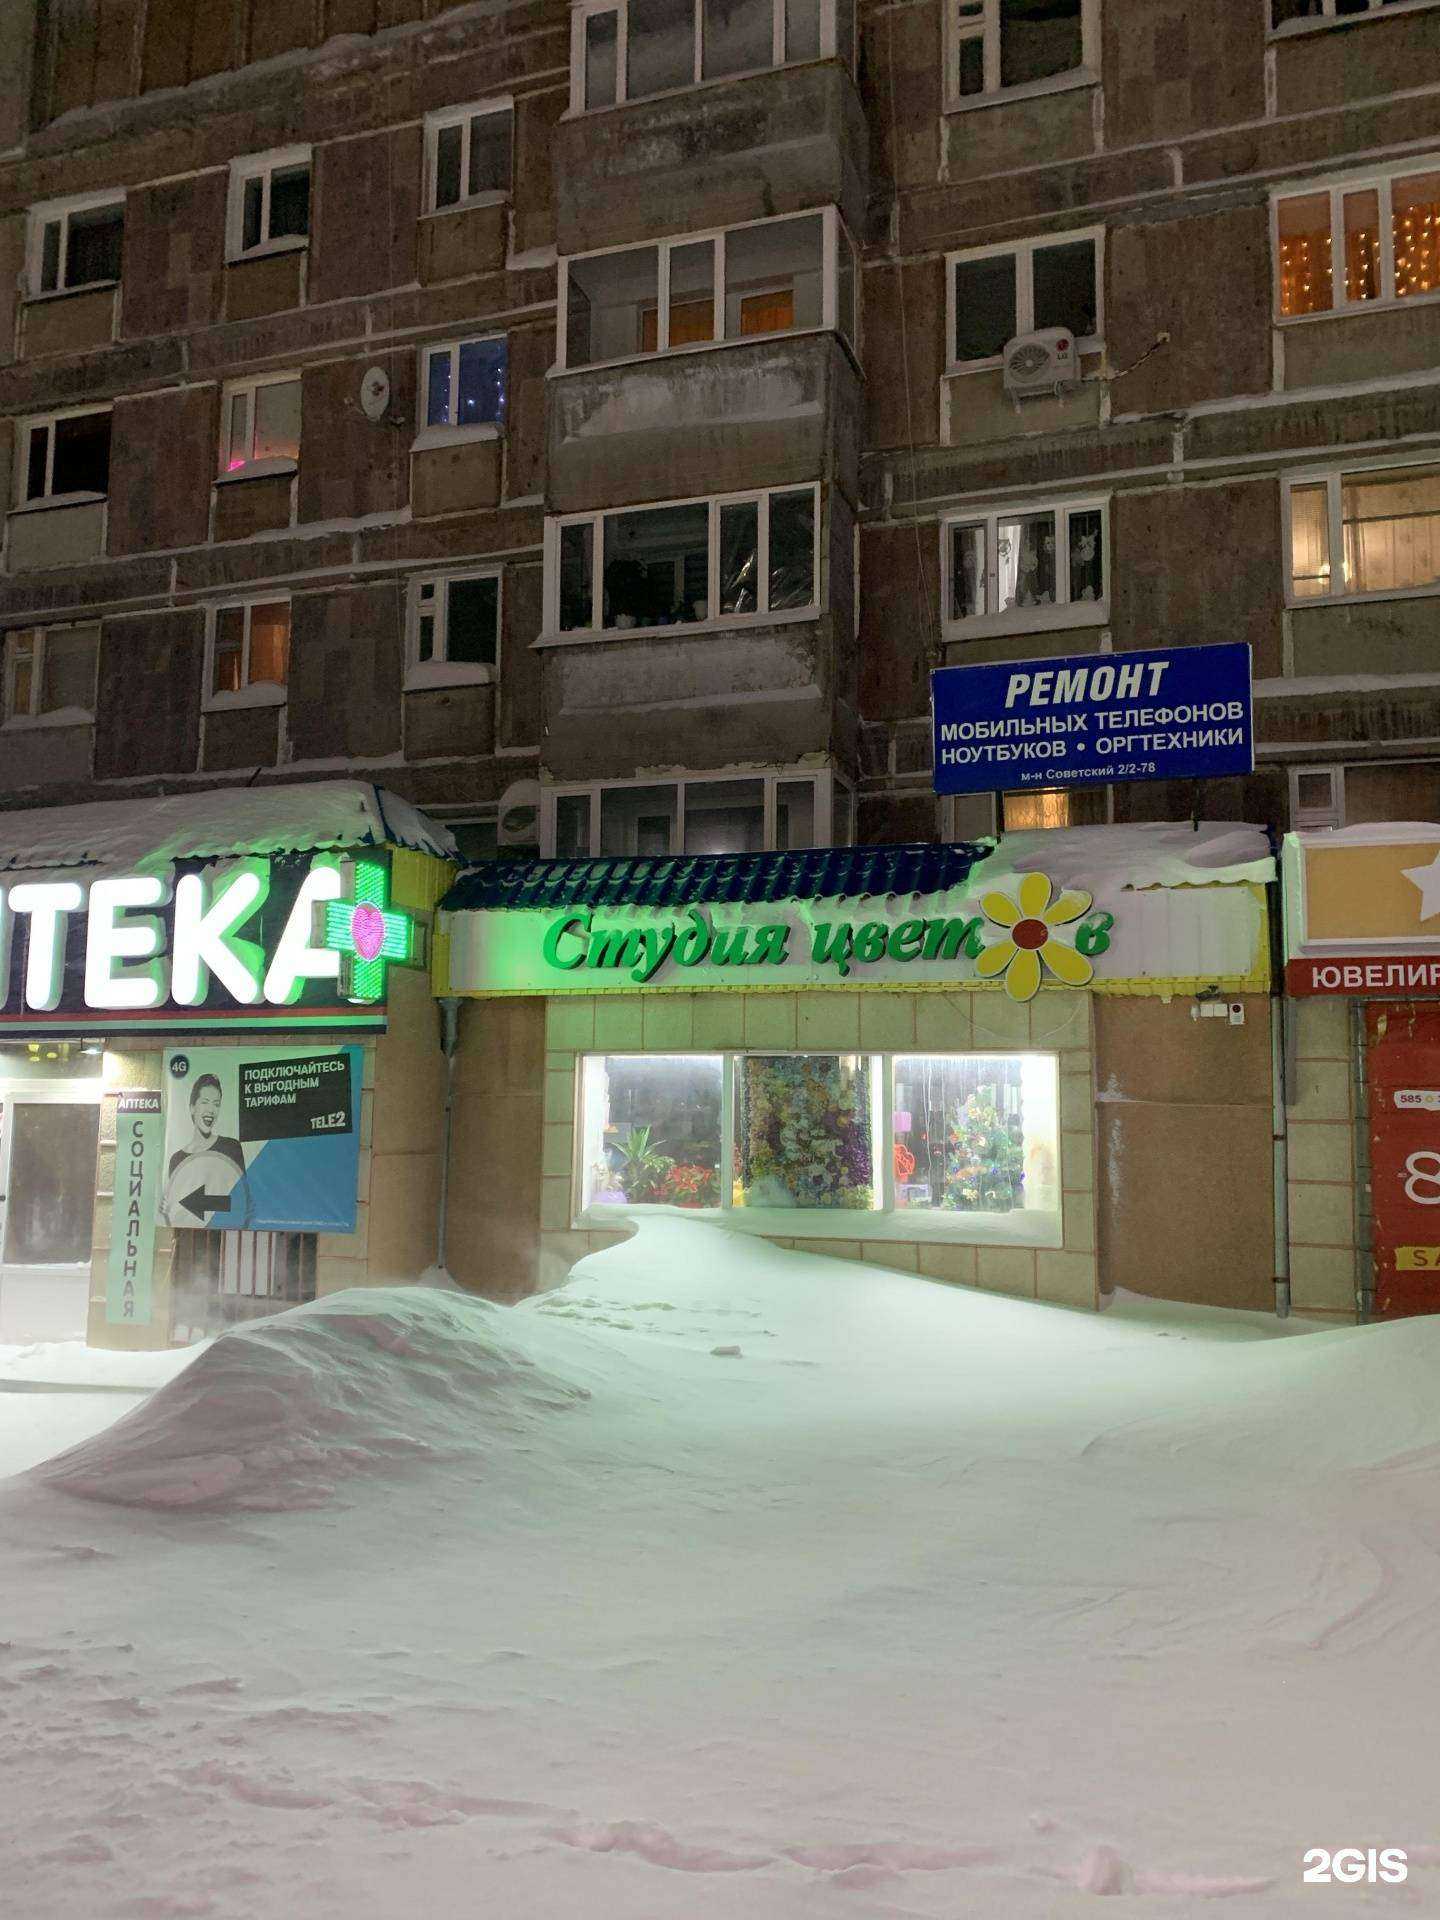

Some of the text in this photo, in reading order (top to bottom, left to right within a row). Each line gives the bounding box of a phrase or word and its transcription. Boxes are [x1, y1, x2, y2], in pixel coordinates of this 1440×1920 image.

[1004, 661, 1169, 708] РЕМОНТ
[941, 701, 1244, 741] МОБИЛЬНЫХ ТЕЛЕФОНОВ
[941, 727, 1243, 765] НОУТБУКОВ ОРГТЕХНИКИ
[1021, 762, 1156, 781] м-н Советский 2/2-78
[542, 910, 791, 982] Студия
[171, 1061, 188, 1073] 4G
[244, 1060, 345, 1081] ПОДКЛЮЧАЙТЕСЬ
[244, 1077, 319, 1094] К ВЫГОДНЫМ
[118, 1097, 160, 1110] АПТЕКА
[244, 1093, 297, 1108] ТАРИФАМ
[1400, 1094, 1422, 1103] 585
[310, 1110, 346, 1130] TELE2
[123, 1120, 144, 1317] СОЦИАЛЬНАЯ
